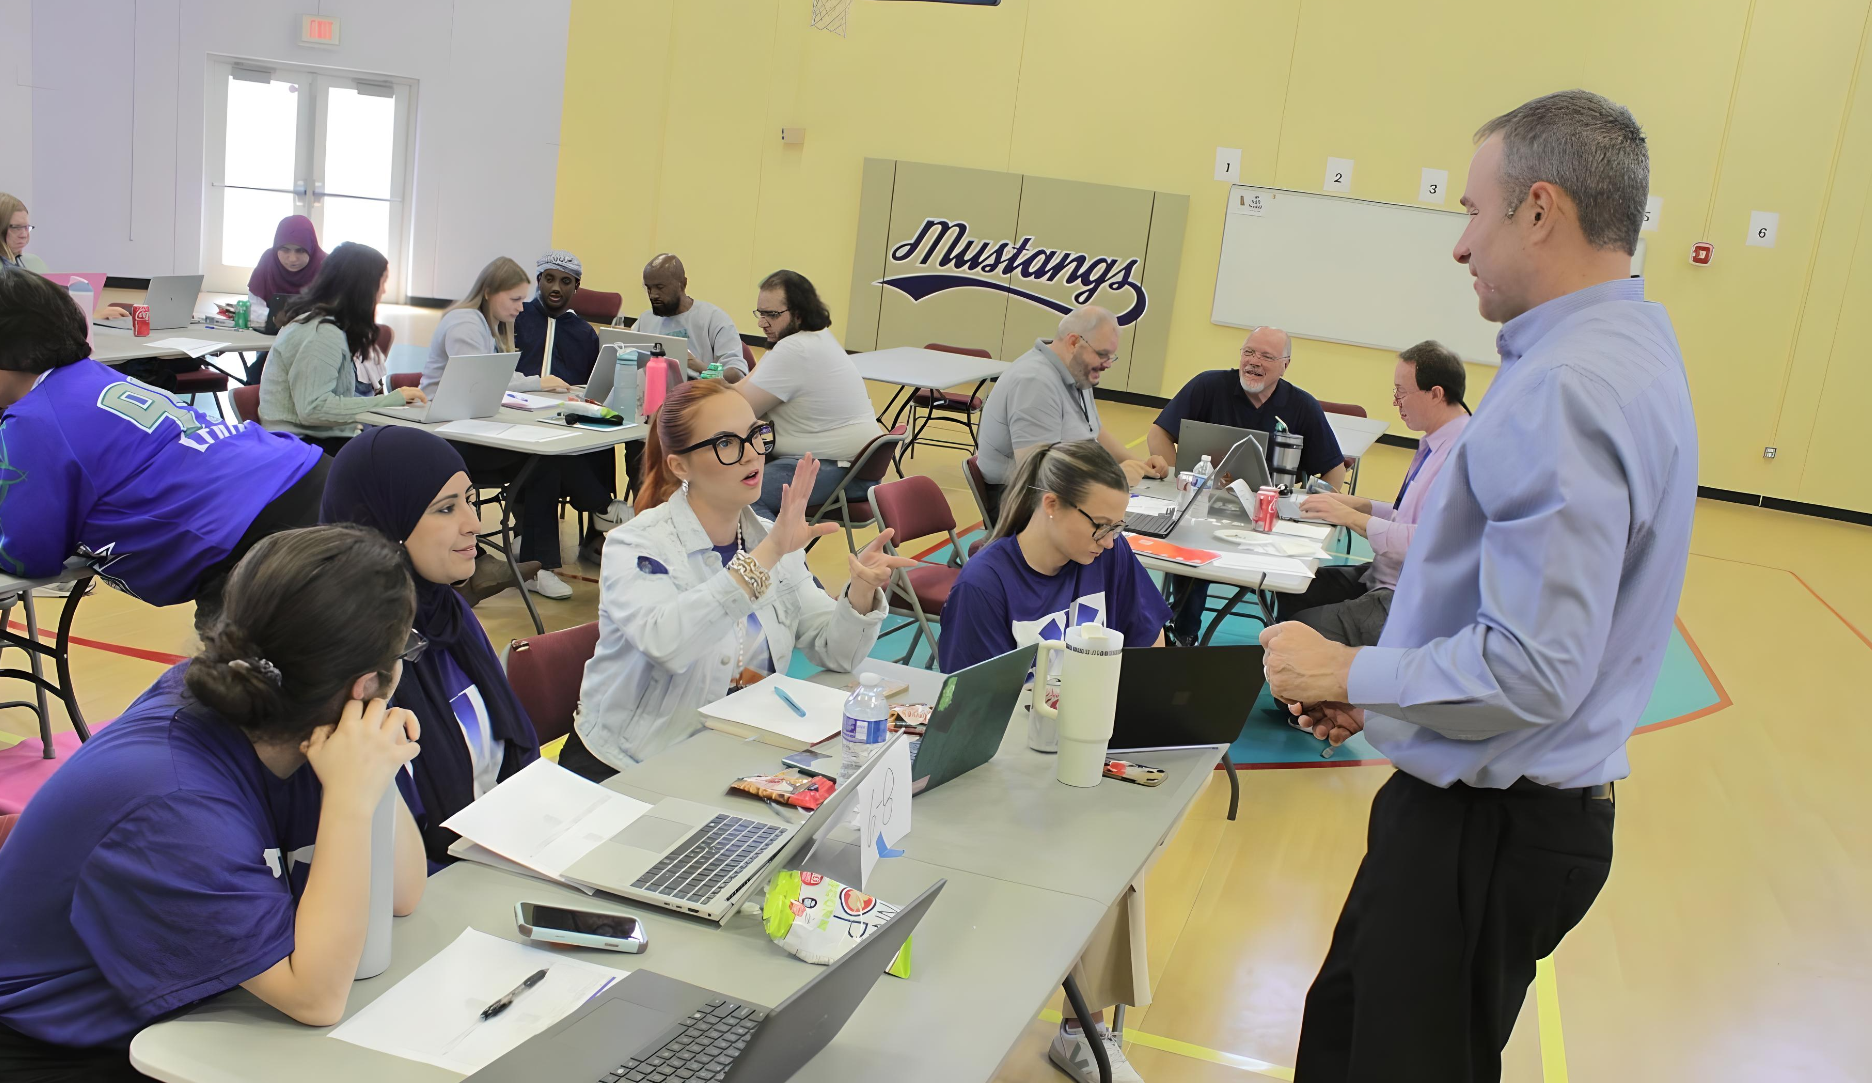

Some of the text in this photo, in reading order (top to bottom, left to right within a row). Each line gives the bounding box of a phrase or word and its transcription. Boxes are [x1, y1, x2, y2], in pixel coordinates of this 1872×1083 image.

[1225, 162, 1231, 173] 1
[1333, 172, 1343, 183] 2
[1428, 184, 1438, 194] 3
[1758, 228, 1768, 239] 6
[891, 218, 1140, 305] Mustangs
